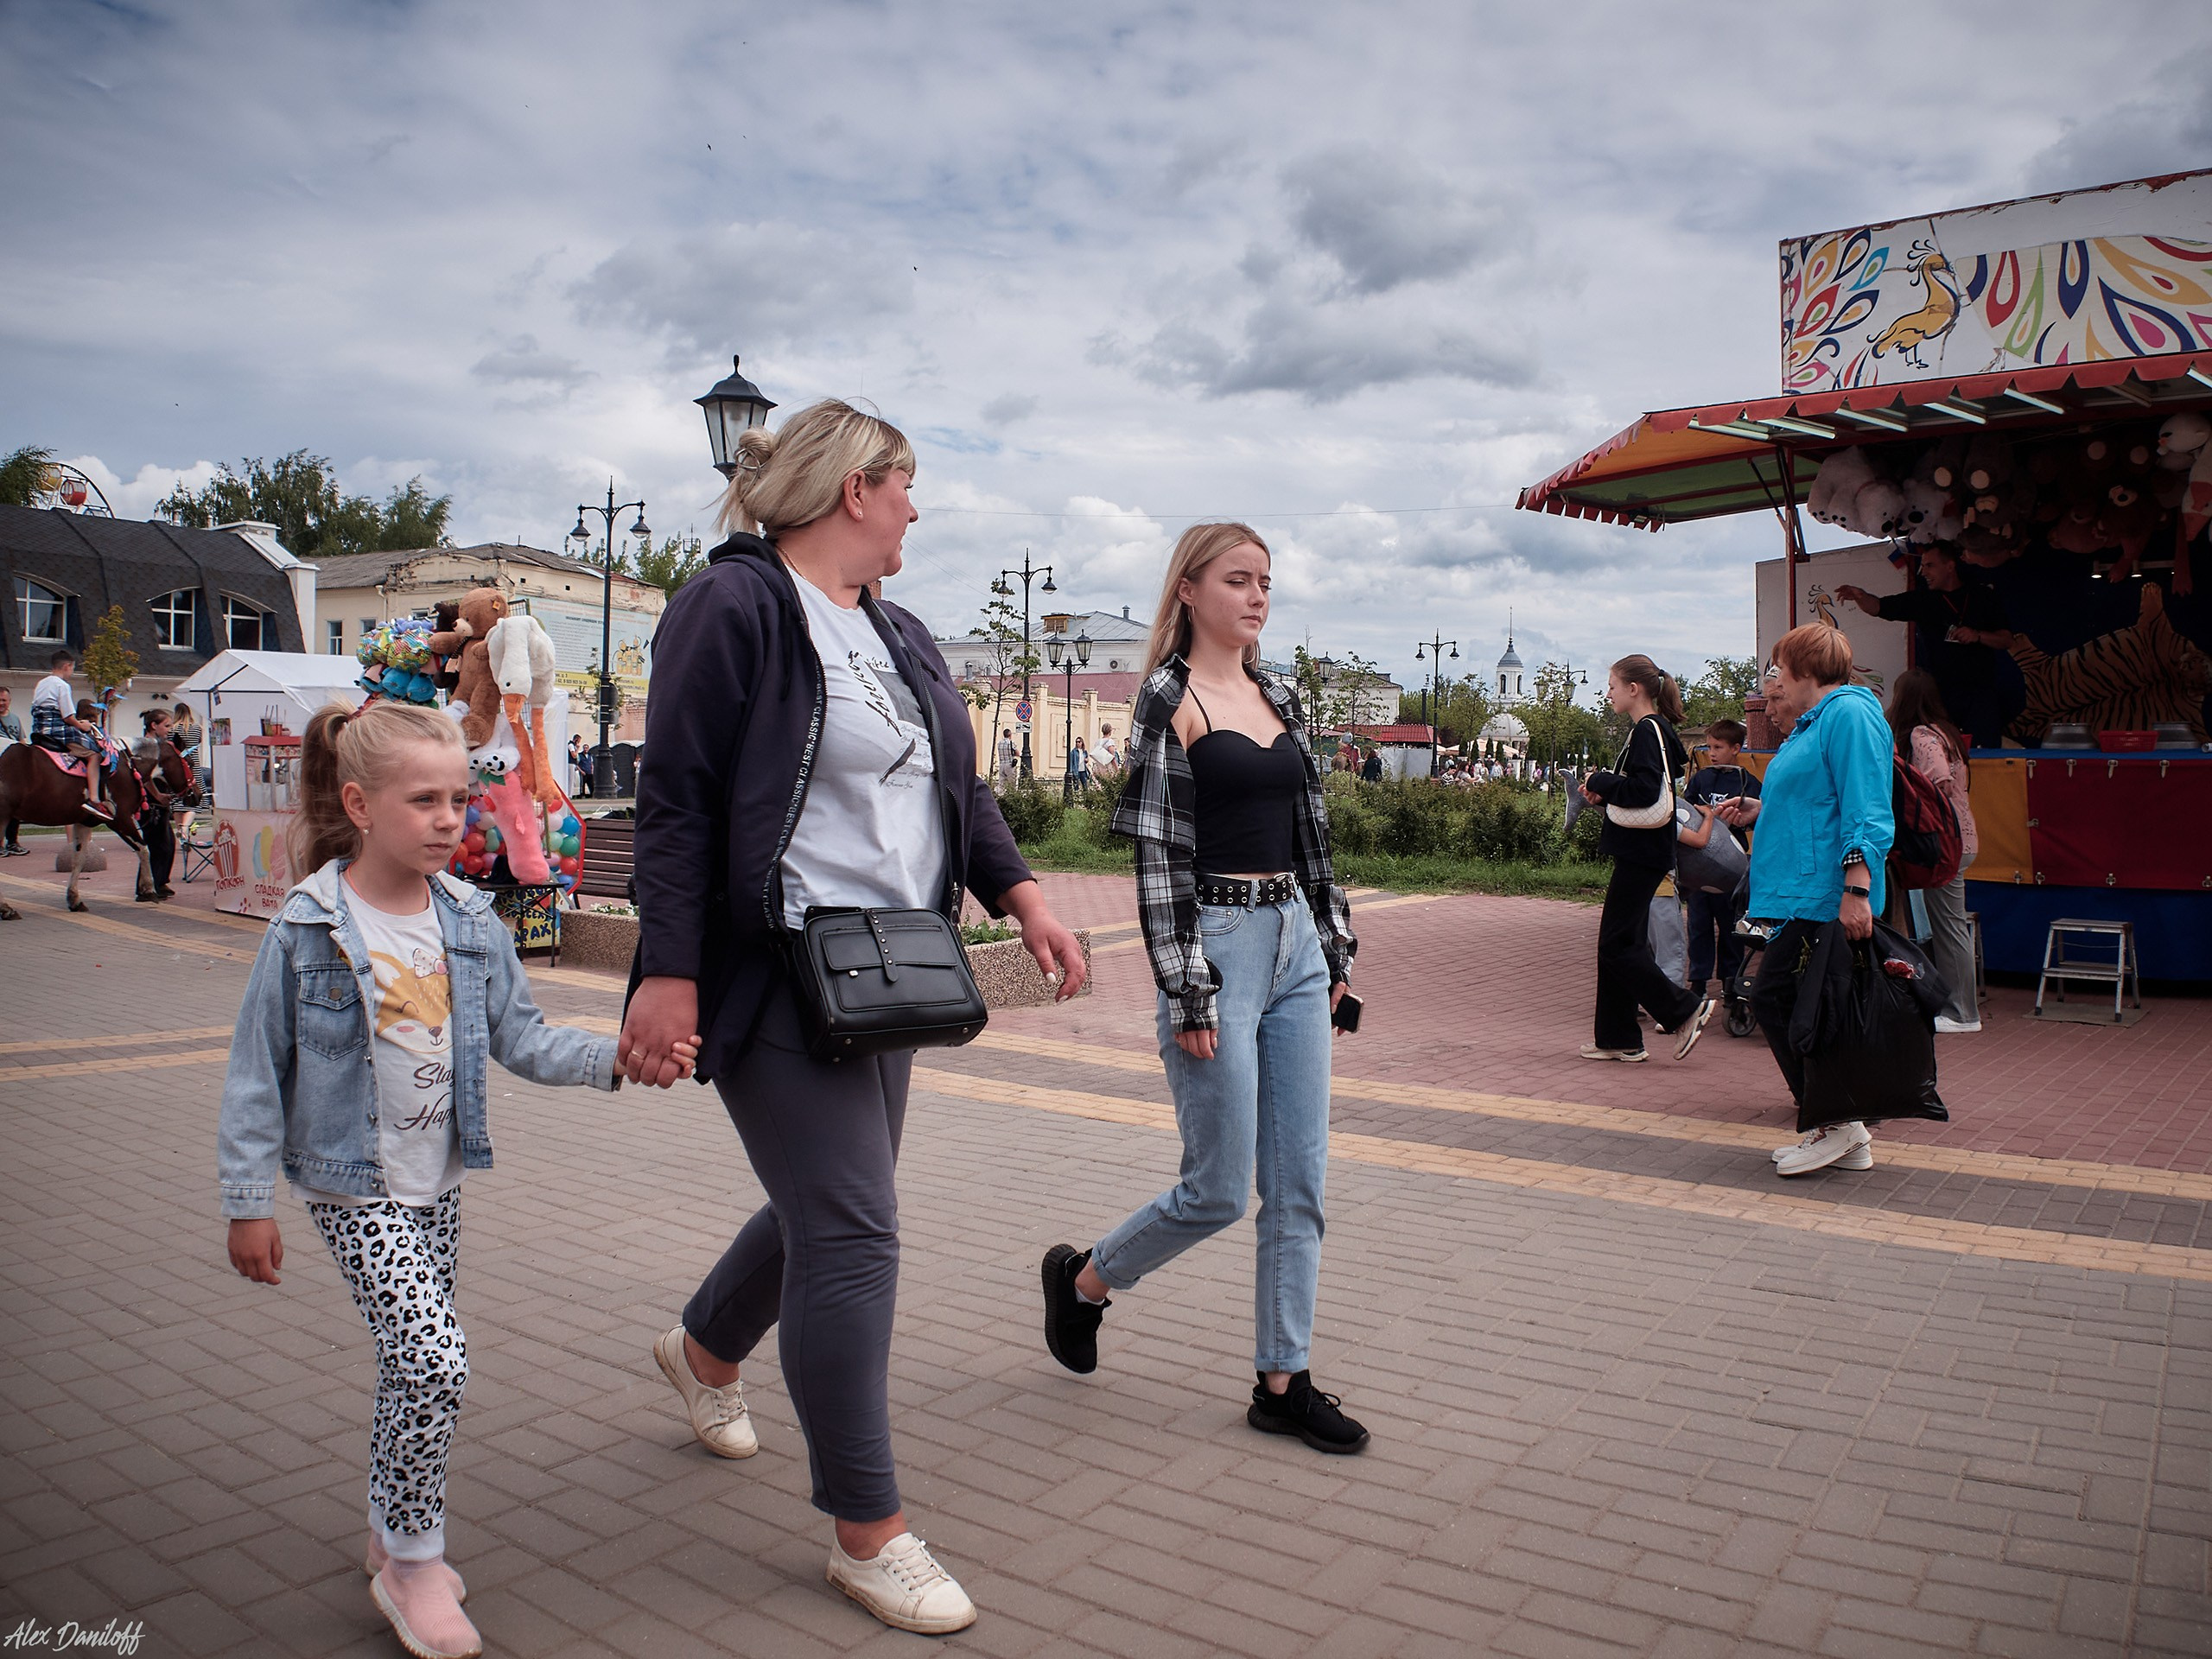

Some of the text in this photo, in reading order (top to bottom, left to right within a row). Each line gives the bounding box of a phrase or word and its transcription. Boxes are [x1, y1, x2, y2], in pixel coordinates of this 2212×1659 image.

[808, 706, 822, 741] CLASSIC
[802, 743, 815, 767] BEST
[791, 766, 809, 804] CLASSIC
[784, 806, 797, 829] BEST
[215, 875, 245, 891] ПОПКОРН
[254, 884, 285, 897] СЛАДКАЯ
[262, 898, 278, 910] ВАТА
